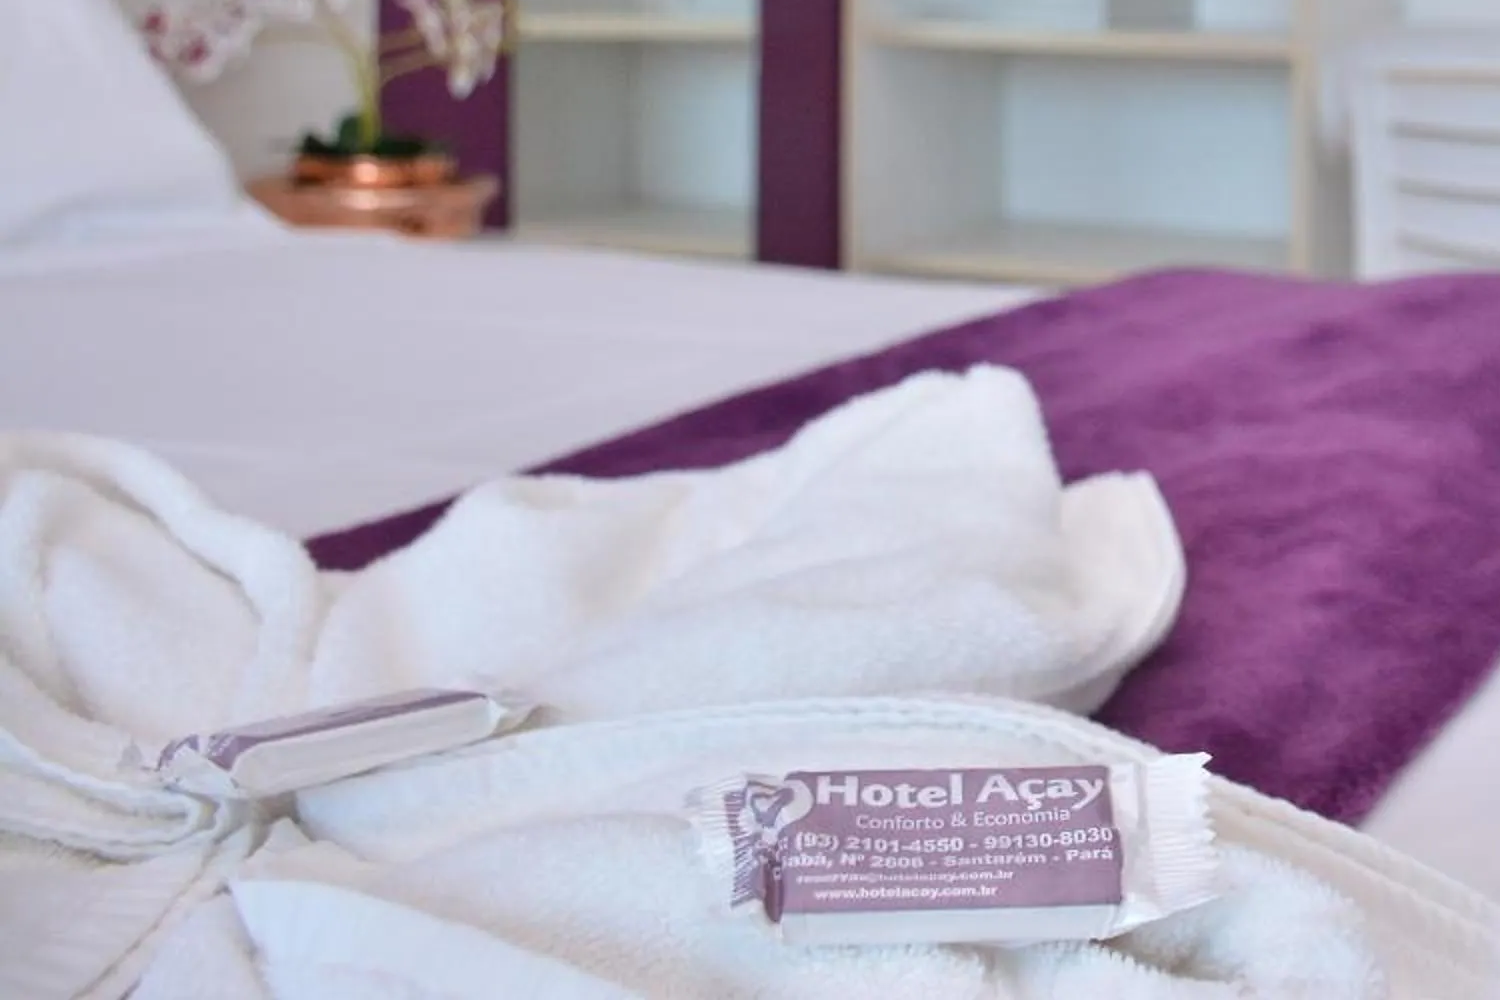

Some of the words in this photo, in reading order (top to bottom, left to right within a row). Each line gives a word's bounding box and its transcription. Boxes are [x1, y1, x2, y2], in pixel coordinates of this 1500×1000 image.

[816, 774, 964, 808] Hotel
[976, 774, 1104, 811] Açay
[856, 815, 944, 830] Conforto
[951, 812, 968, 828] &
[973, 808, 1071, 828] Economia
[795, 831, 840, 851] (93)
[847, 836, 963, 853] 2101-4550
[985, 827, 1113, 850] 99130-8030
[1065, 846, 1113, 861] Pará
